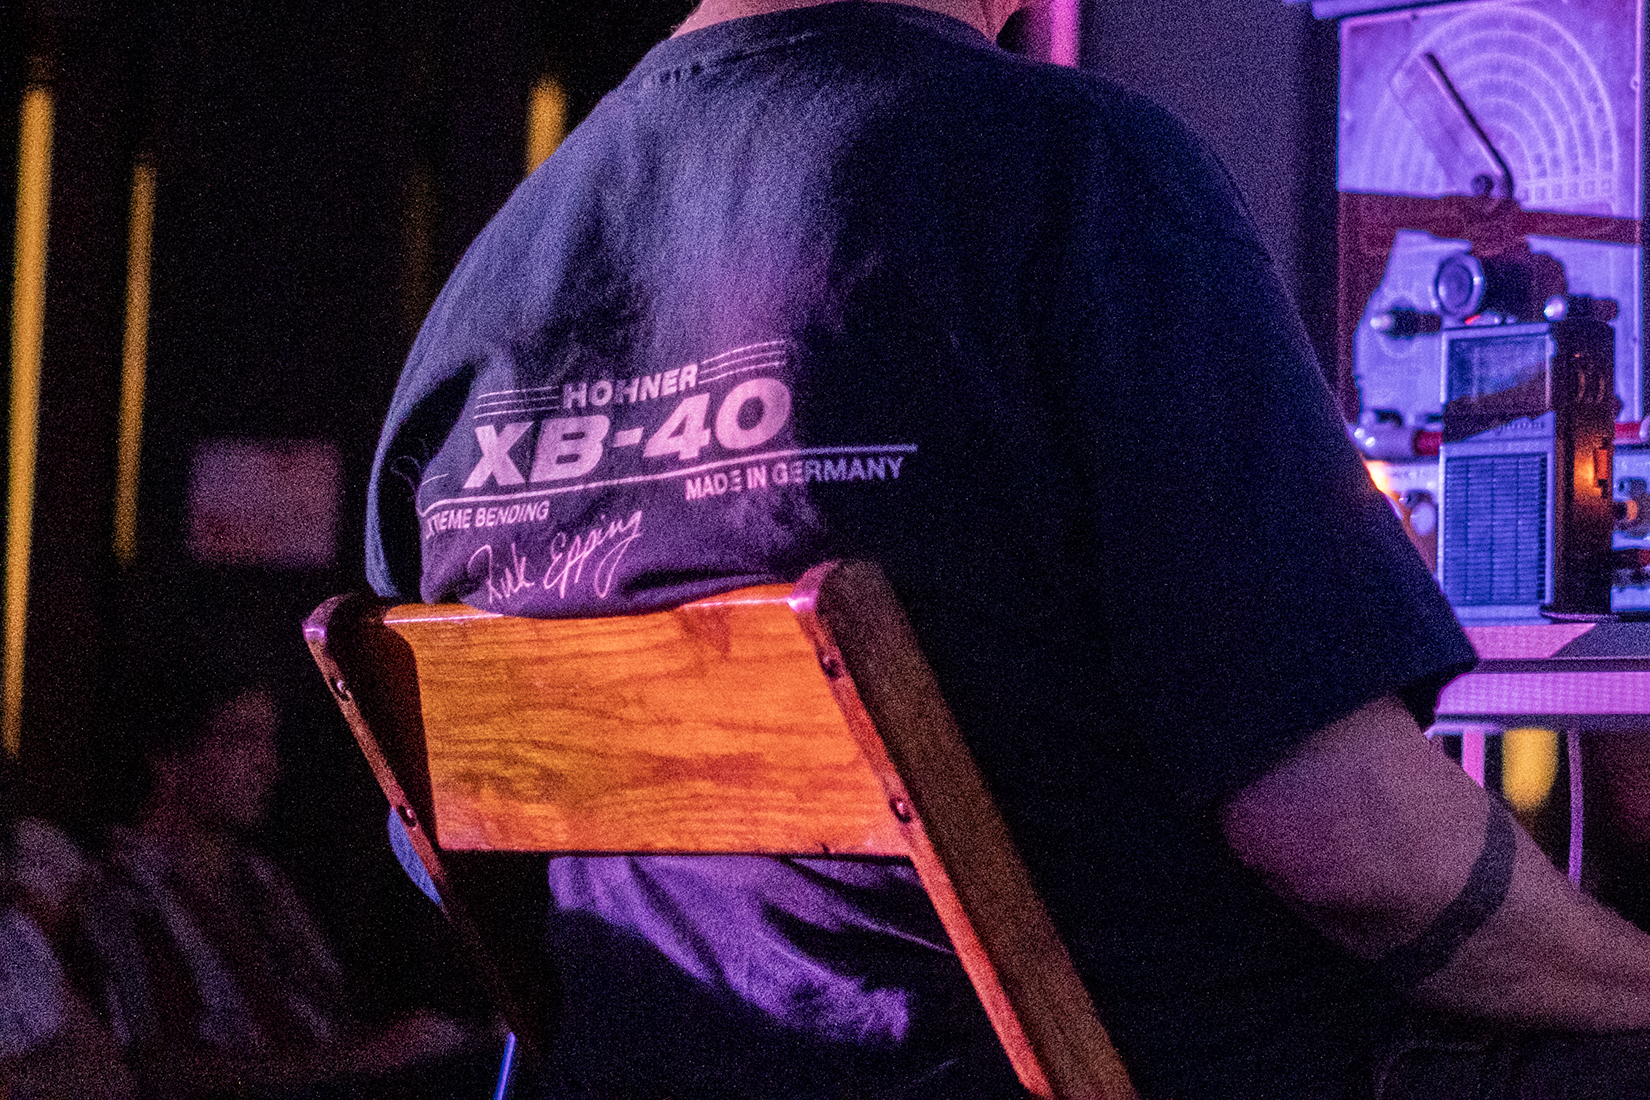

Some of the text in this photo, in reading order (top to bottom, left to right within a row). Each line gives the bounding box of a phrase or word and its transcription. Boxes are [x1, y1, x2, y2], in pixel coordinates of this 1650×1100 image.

[562, 363, 699, 409] HOHNER
[463, 378, 793, 491] XB-40
[685, 456, 904, 501] MADE IN GERMANY
[475, 500, 550, 528] BENDING
